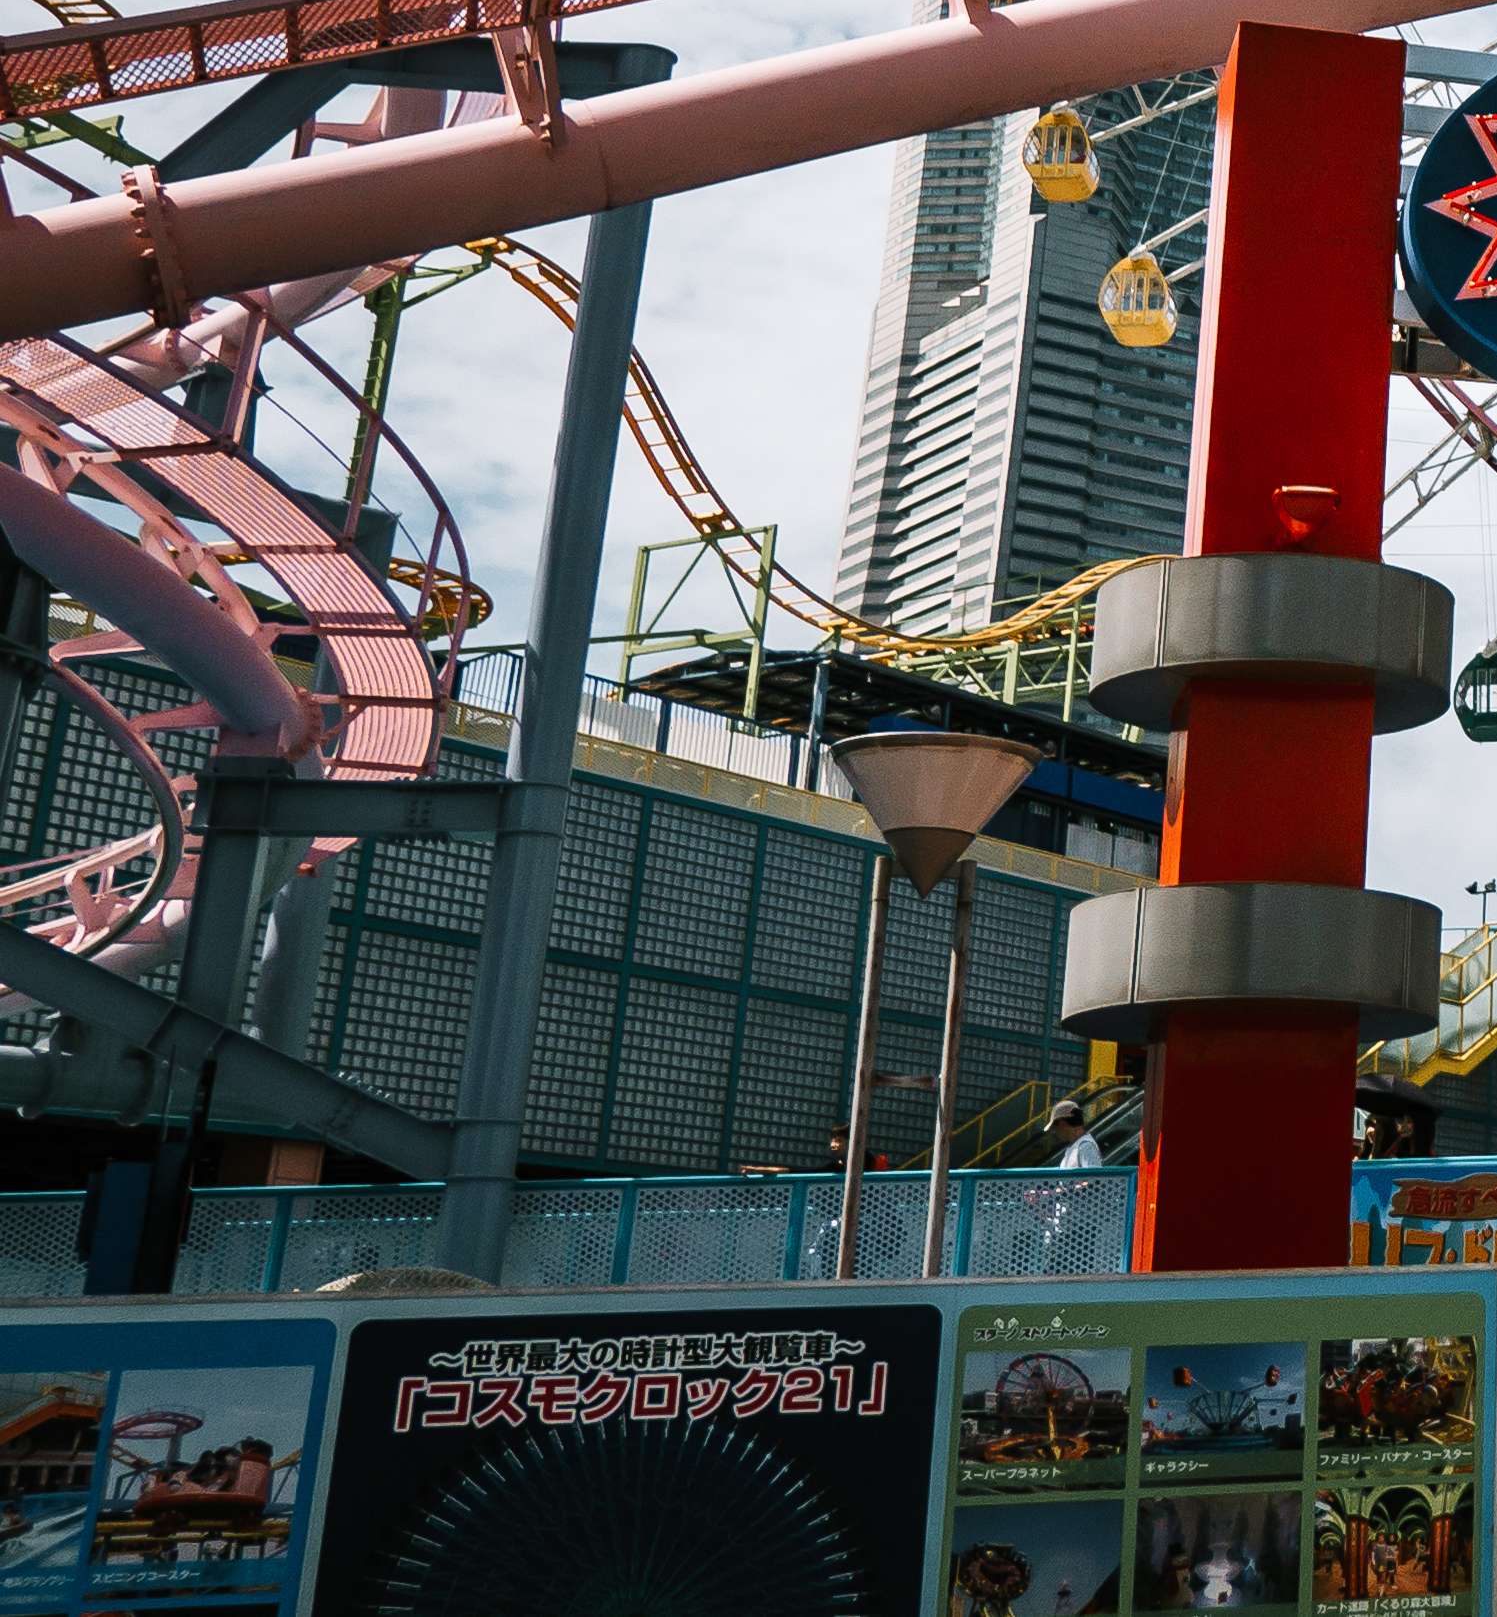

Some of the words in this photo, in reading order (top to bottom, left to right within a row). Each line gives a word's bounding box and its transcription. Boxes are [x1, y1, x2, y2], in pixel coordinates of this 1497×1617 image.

[392, 1363, 888, 1433] 「コスモクロック21」
[1144, 1460, 1209, 1474] ギャラクシー
